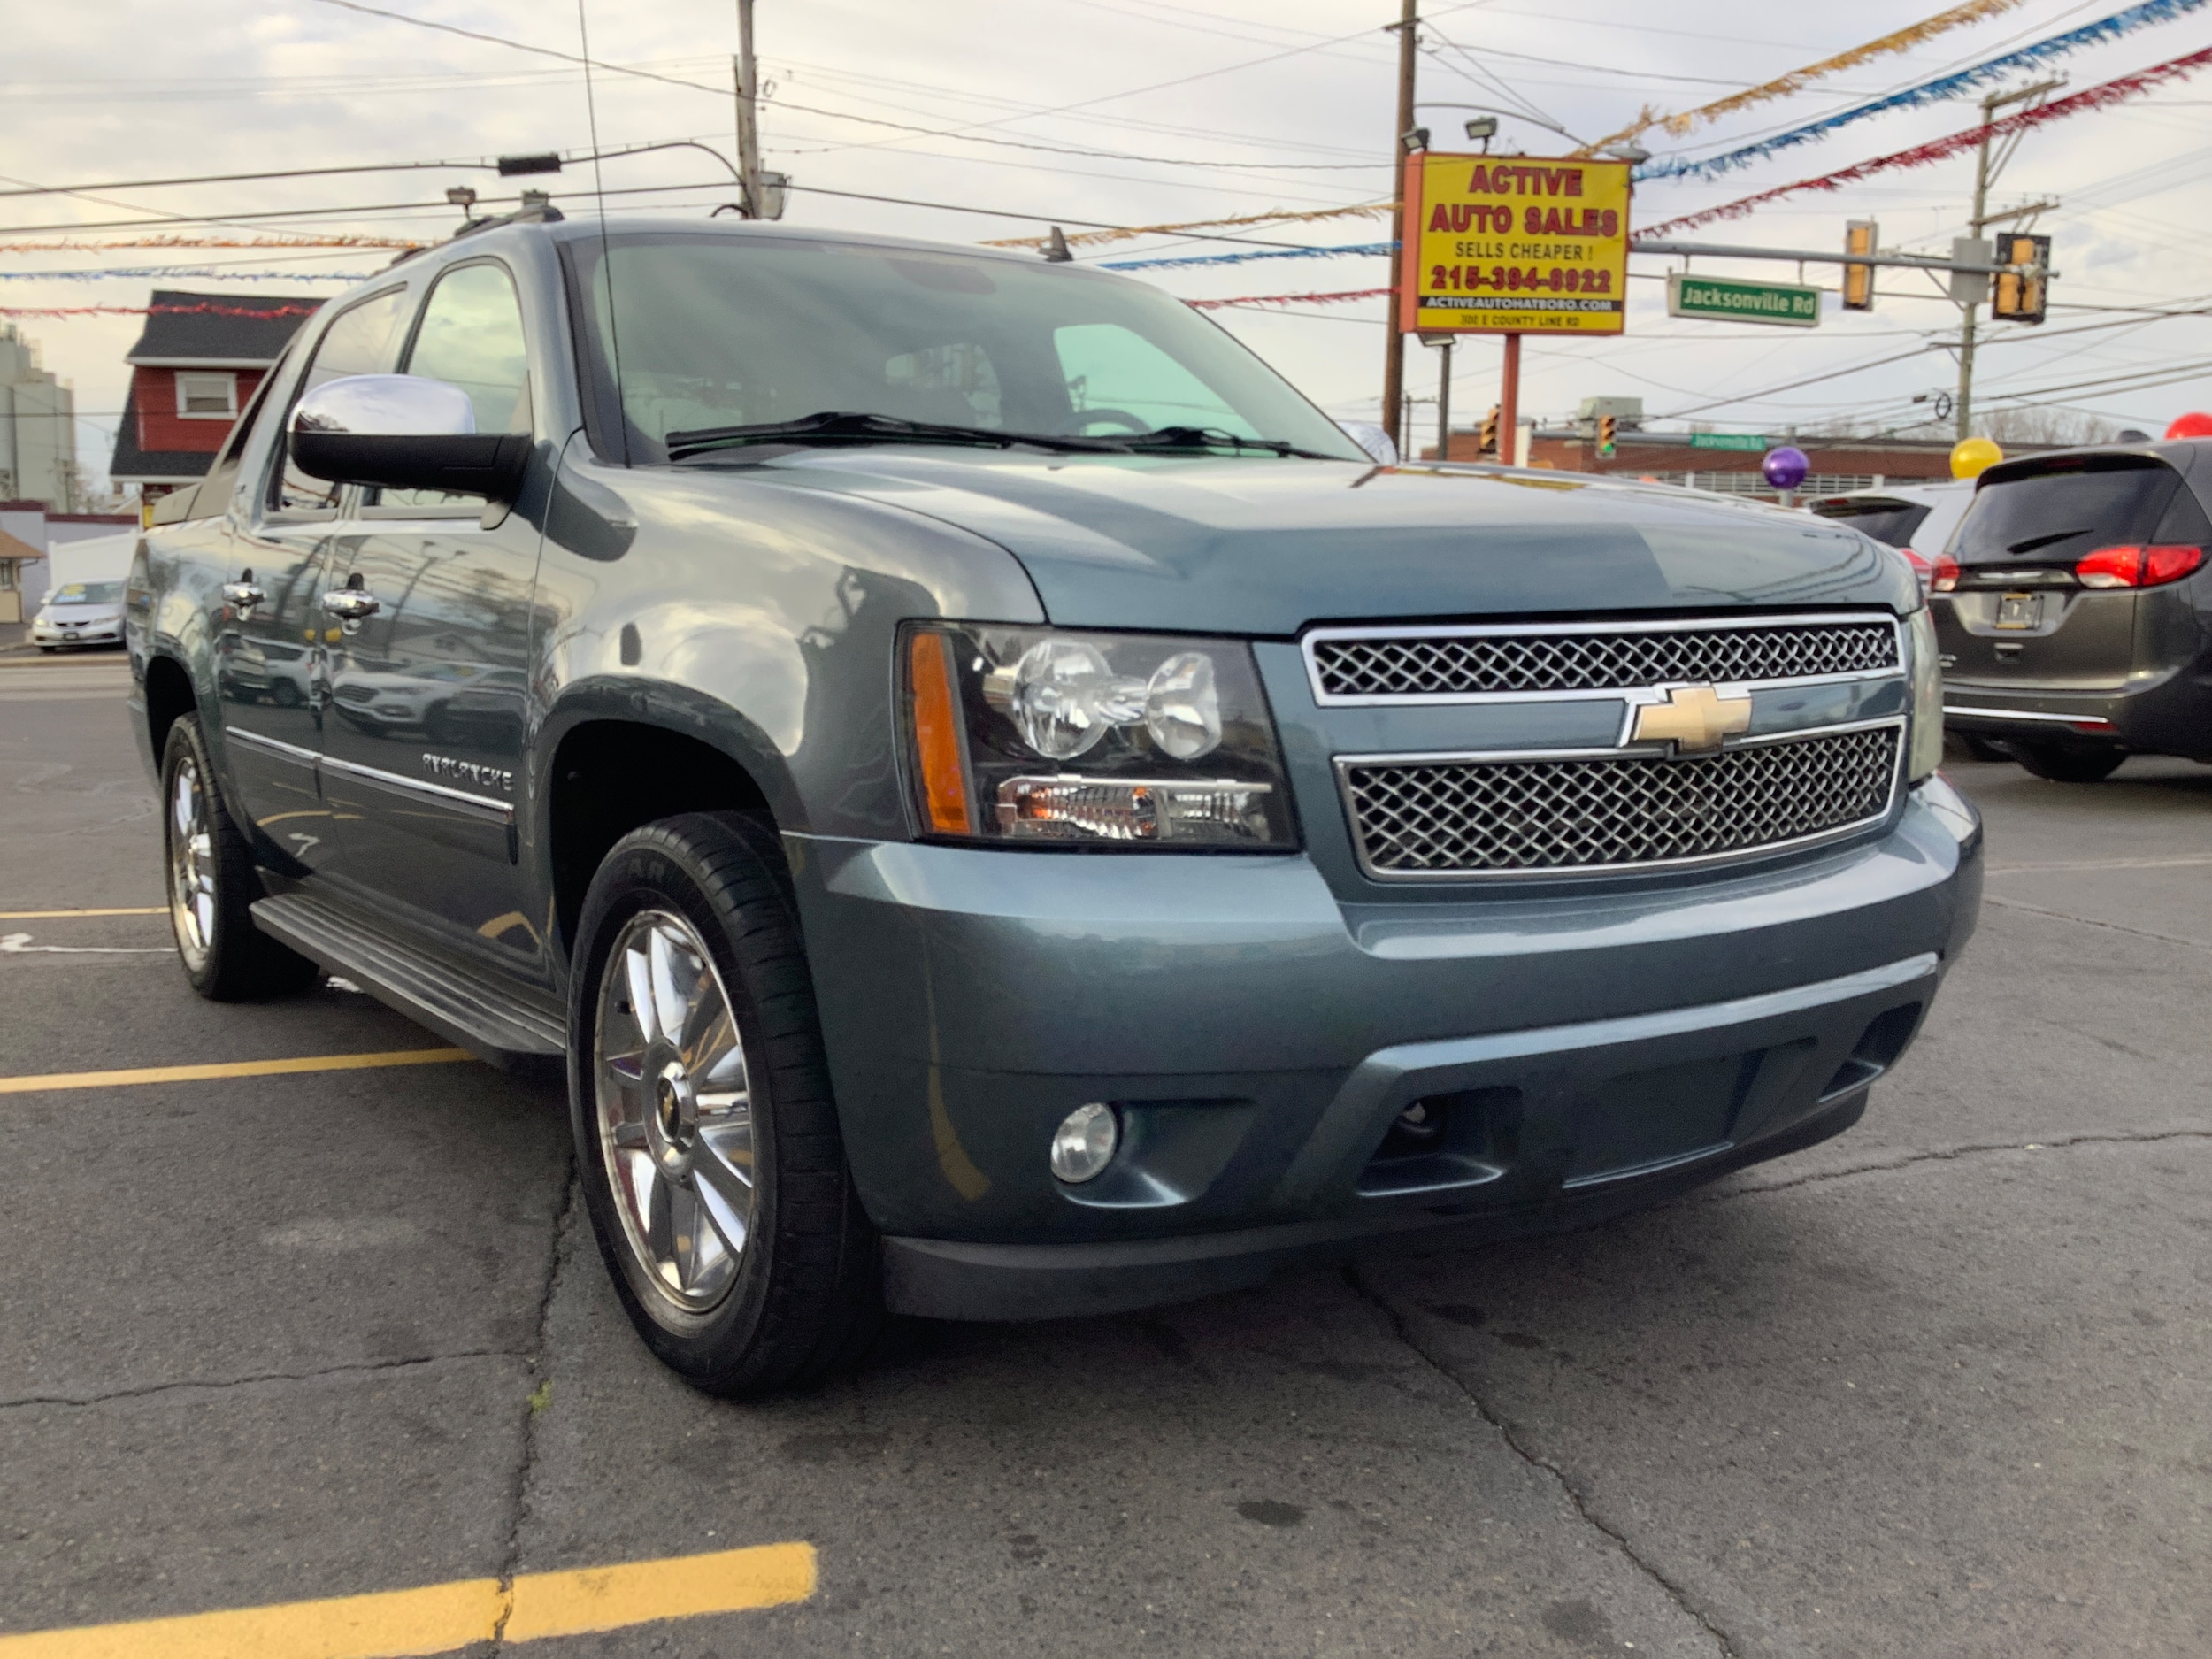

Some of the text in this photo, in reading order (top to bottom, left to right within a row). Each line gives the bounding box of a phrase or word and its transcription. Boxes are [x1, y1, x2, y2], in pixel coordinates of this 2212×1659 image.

[1469, 165, 1583, 196] ACTIVE
[1428, 204, 1618, 237] AUTO SALES
[1455, 242, 1504, 258] SELLS
[1510, 243, 1583, 261] CHEAPER
[1431, 265, 1611, 293] 215-394-8922
[1684, 286, 1814, 315] Jacksonville Rd
[1493, 315, 1534, 326] COUNTY
[1540, 317, 1561, 326] LINE
